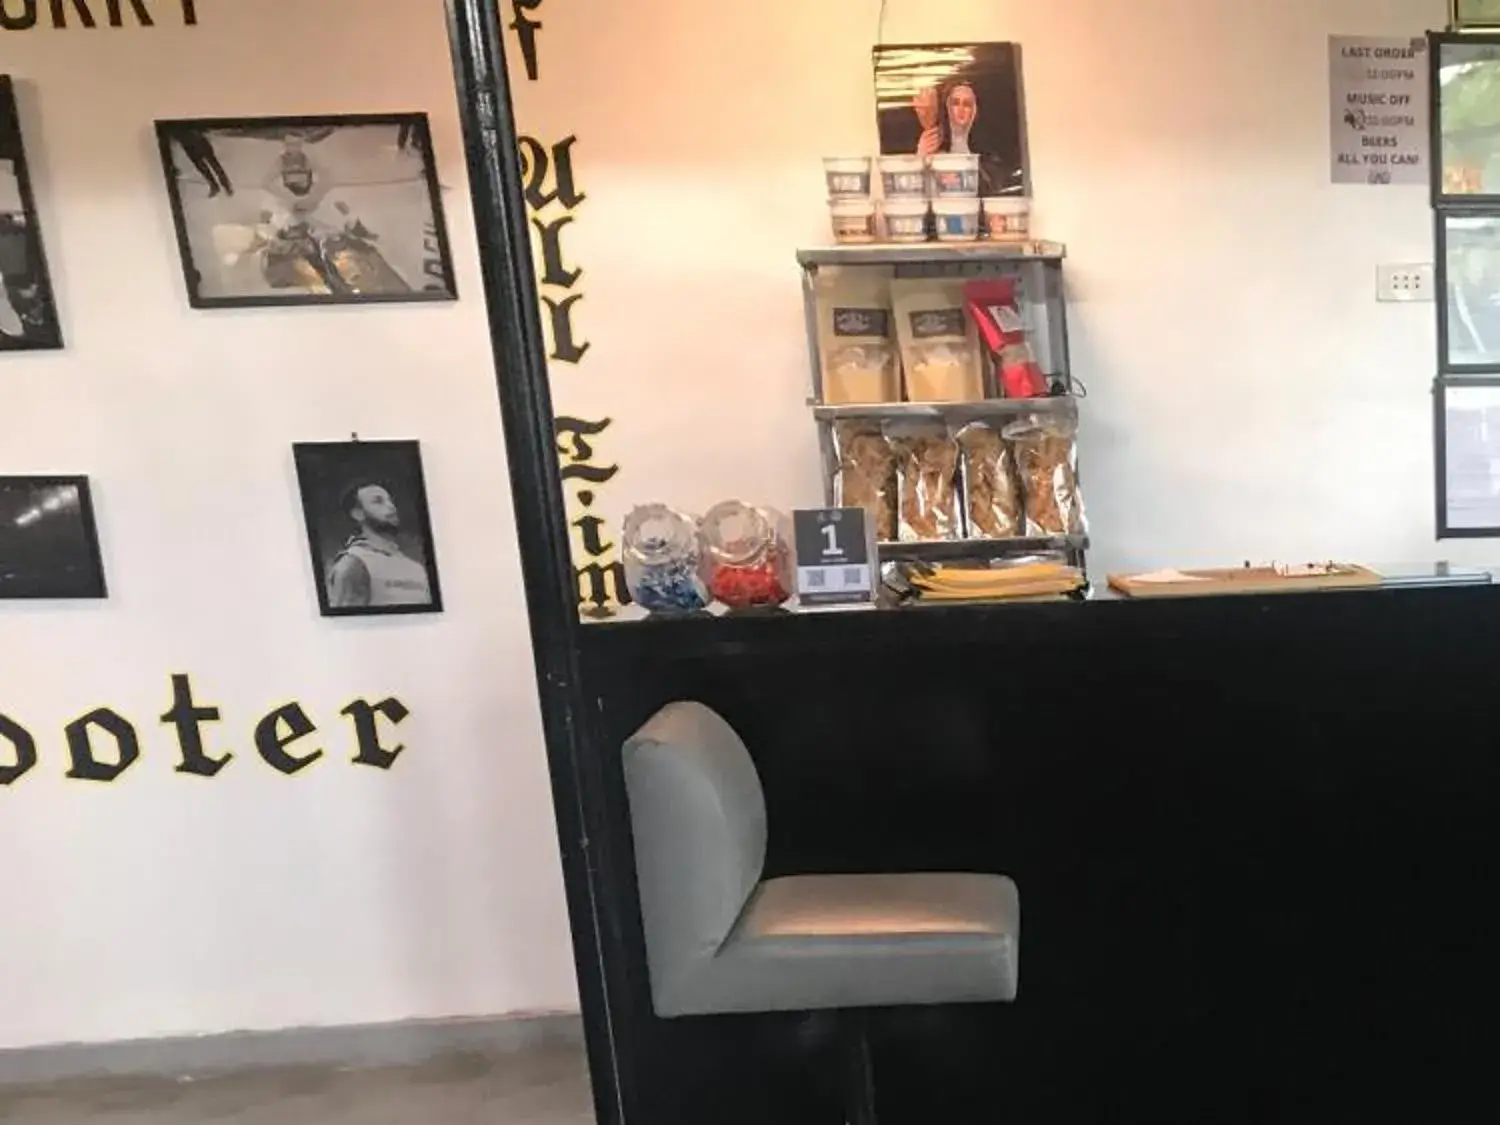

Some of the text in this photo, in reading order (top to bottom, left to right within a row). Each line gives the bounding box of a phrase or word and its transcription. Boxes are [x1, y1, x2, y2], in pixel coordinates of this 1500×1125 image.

[1341, 46, 1415, 58] LAST ORDER
[1346, 93, 1411, 105] MUSIC OFF
[1361, 135, 1398, 147] BEERS
[1337, 153, 1359, 164] ALL
[1362, 153, 1387, 164] YOU
[821, 524, 844, 555] 1
